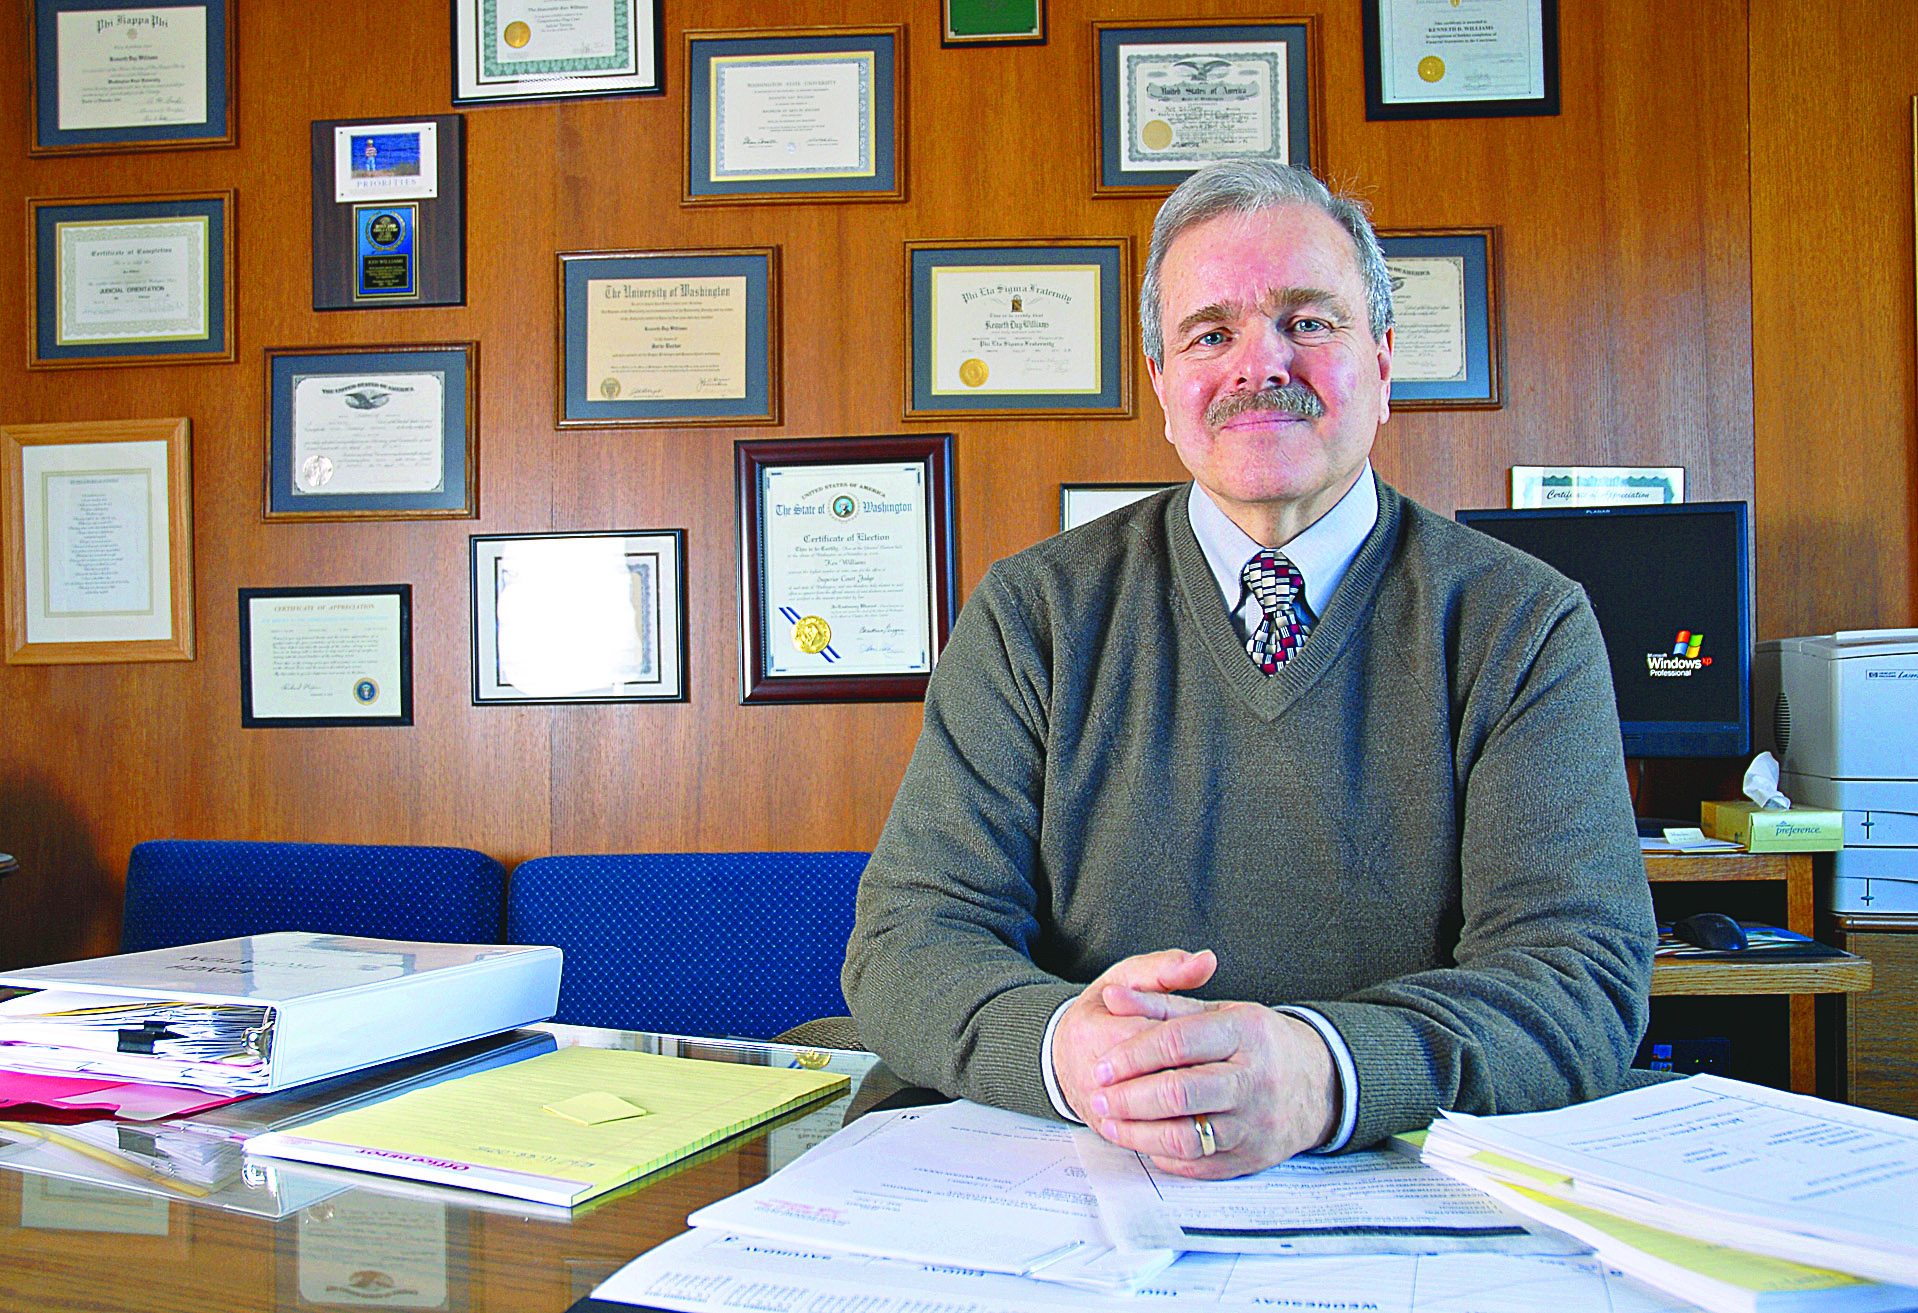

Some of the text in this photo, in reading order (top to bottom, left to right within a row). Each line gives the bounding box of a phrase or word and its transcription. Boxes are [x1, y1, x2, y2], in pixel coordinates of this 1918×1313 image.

[97, 15, 168, 33] Phi Kappa Phi
[1160, 86, 1247, 95] United States of America
[357, 179, 417, 188] PRIORITIES
[91, 249, 124, 257] Certificate
[126, 285, 165, 293] ORIENTATION
[605, 283, 731, 300] The University of Washington
[961, 283, 1072, 305] Phi Eta Sigma Fraternity
[985, 320, 1009, 330] Kenneth
[1023, 320, 1050, 329] Williams
[1024, 340, 1055, 348] Fraternity
[801, 487, 824, 500] UNITED
[825, 482, 848, 490] STATES
[859, 484, 886, 498] AMERICA
[776, 500, 912, 516] The State of Washington
[803, 532, 890, 544] Certificate of Election
[840, 558, 867, 566] Williams
[857, 574, 875, 583] Judge
[328, 603, 375, 611] APPRECIATION
[1647, 657, 1702, 669] Windows
[1252, 1298, 1379, 1311] WEDNESDAY
